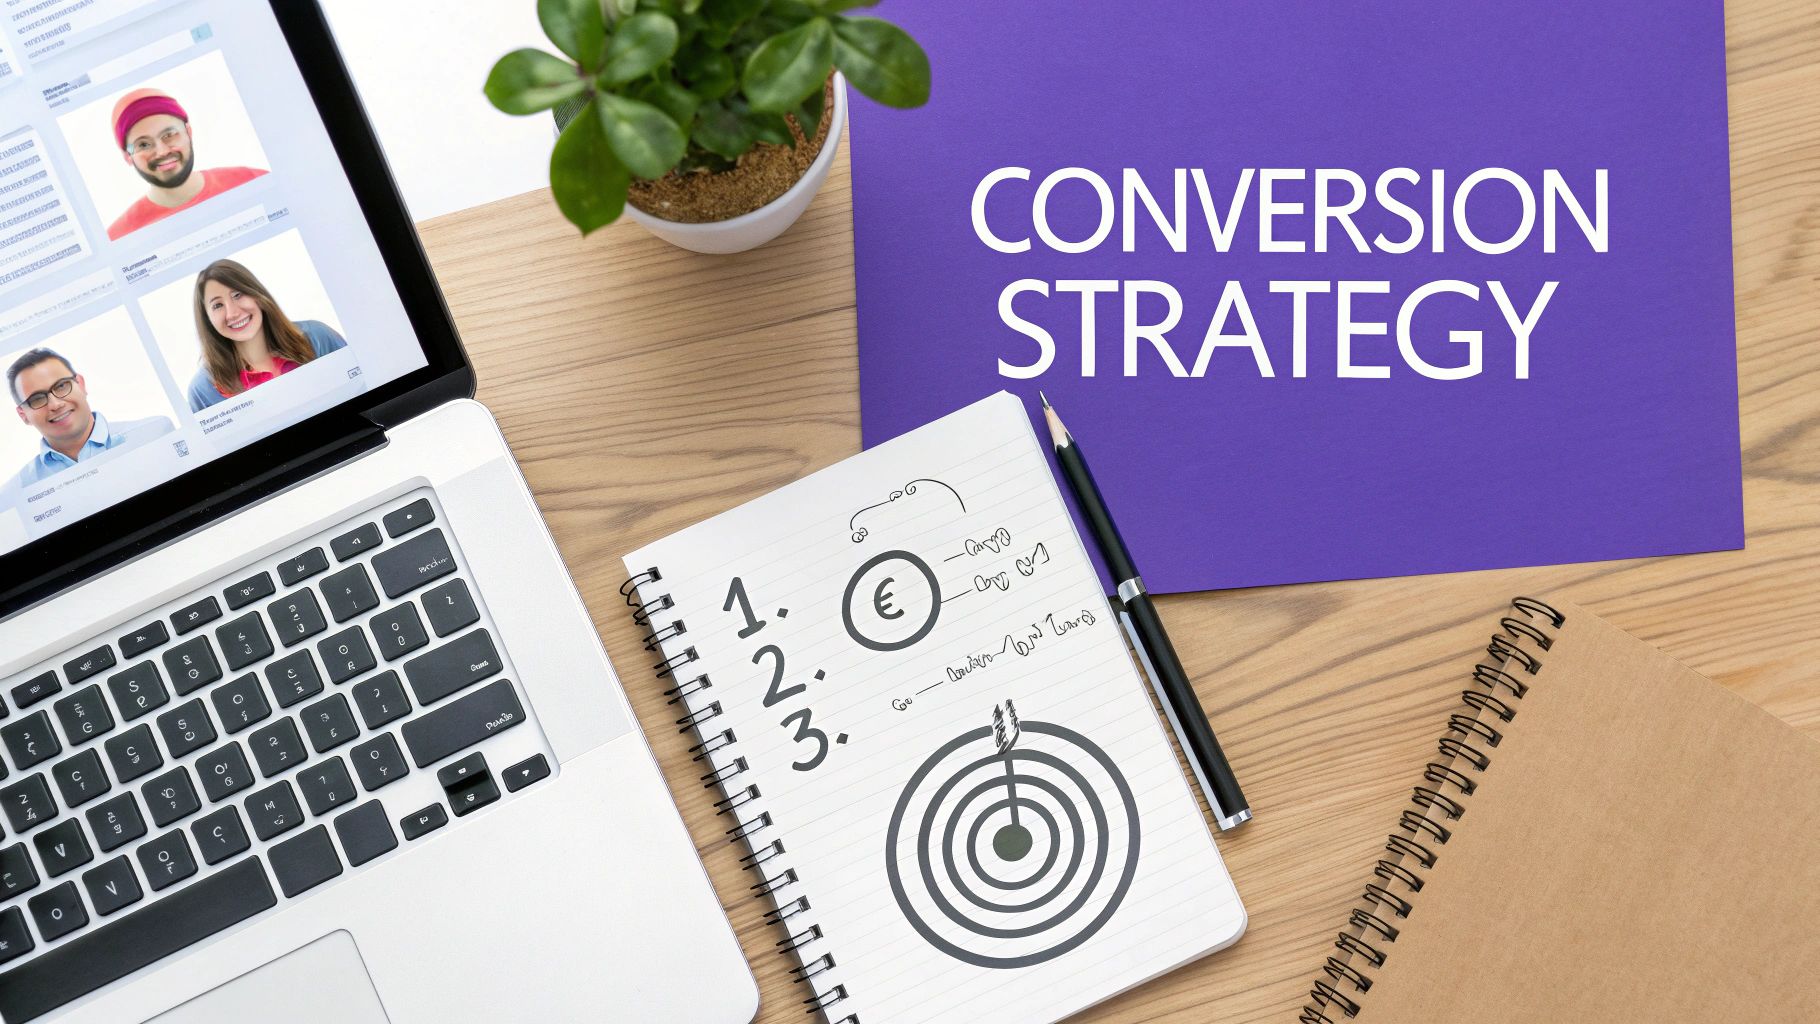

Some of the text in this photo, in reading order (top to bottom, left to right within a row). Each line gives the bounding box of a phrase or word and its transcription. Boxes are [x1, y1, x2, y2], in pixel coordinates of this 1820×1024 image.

[971, 166, 1609, 255] CONVERSION
[997, 278, 1560, 381] STRATEGY
[722, 576, 789, 640] 1.
[873, 577, 905, 620] €
[751, 644, 827, 709] 2.
[780, 707, 849, 772] 3.
